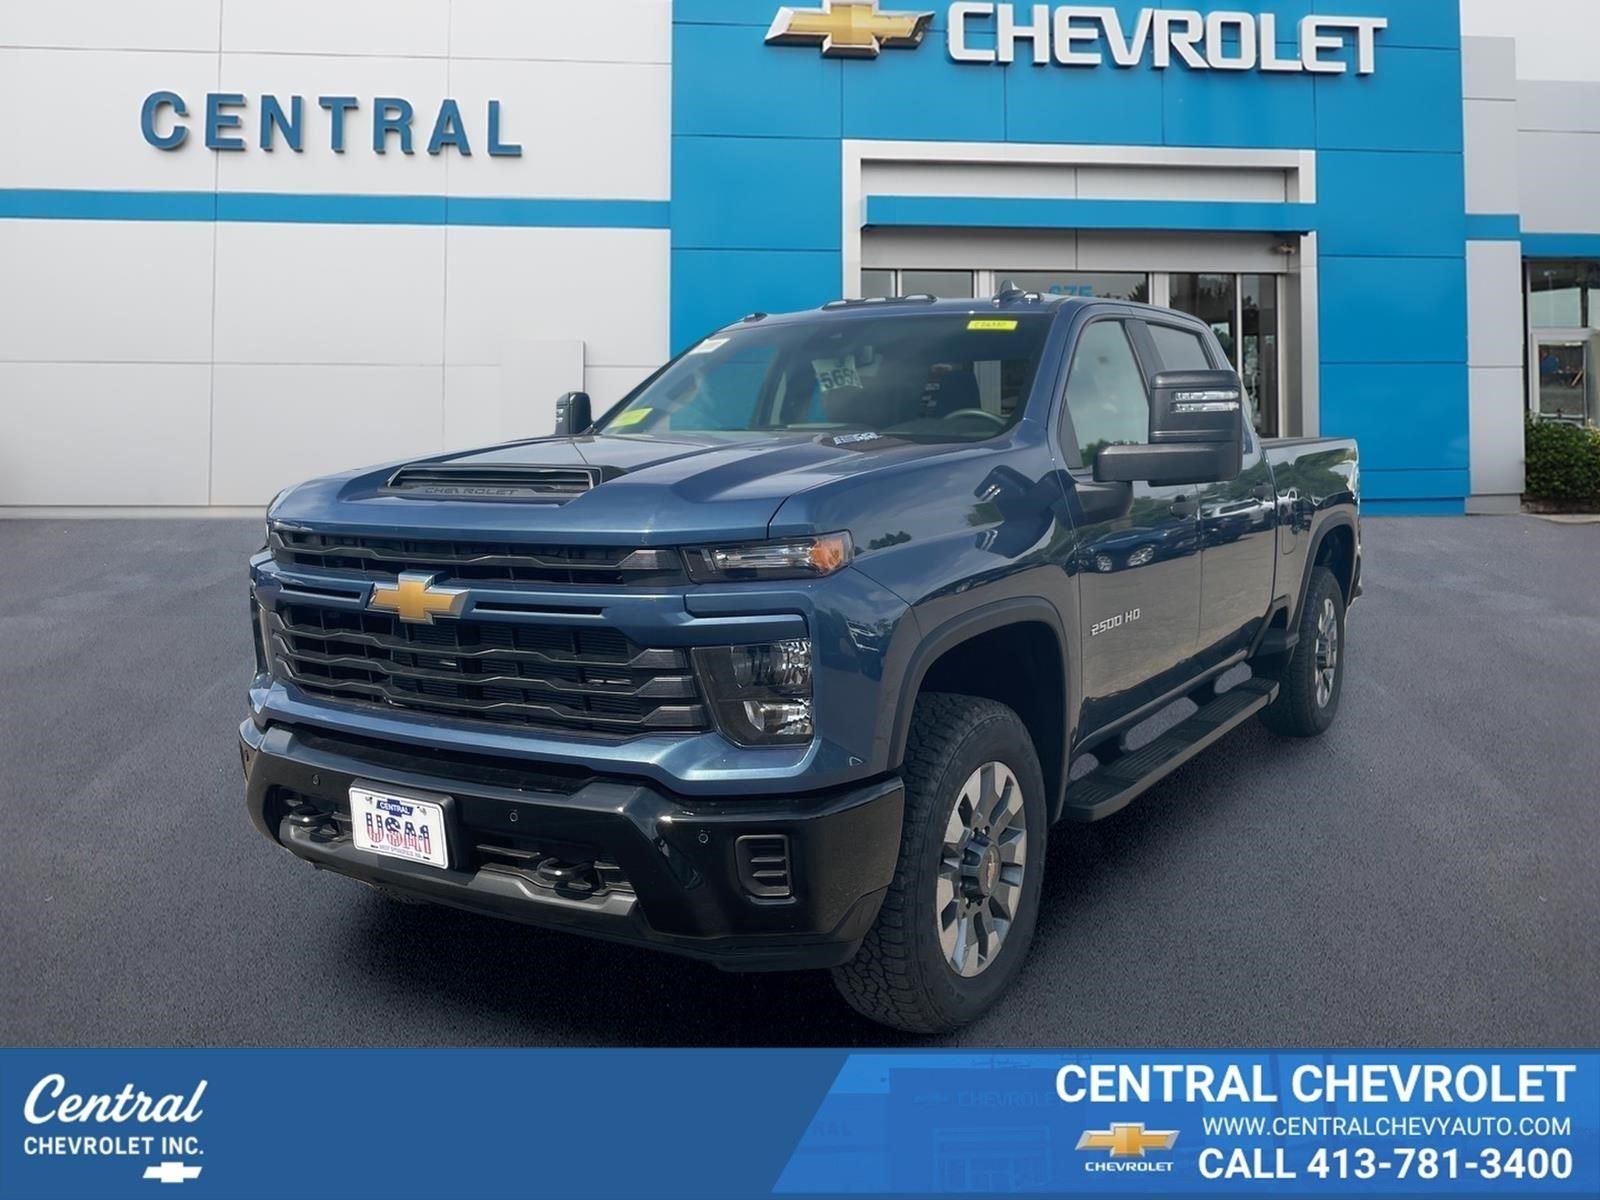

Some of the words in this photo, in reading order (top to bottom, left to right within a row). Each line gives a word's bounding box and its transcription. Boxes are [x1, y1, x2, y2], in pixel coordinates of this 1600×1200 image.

[947, 1, 1388, 75] CHEVROLET
[140, 91, 522, 158] CENTRAL
[1091, 614, 1122, 636] 2500
[1124, 608, 1140, 623] HD
[379, 801, 410, 814] CENTRAL
